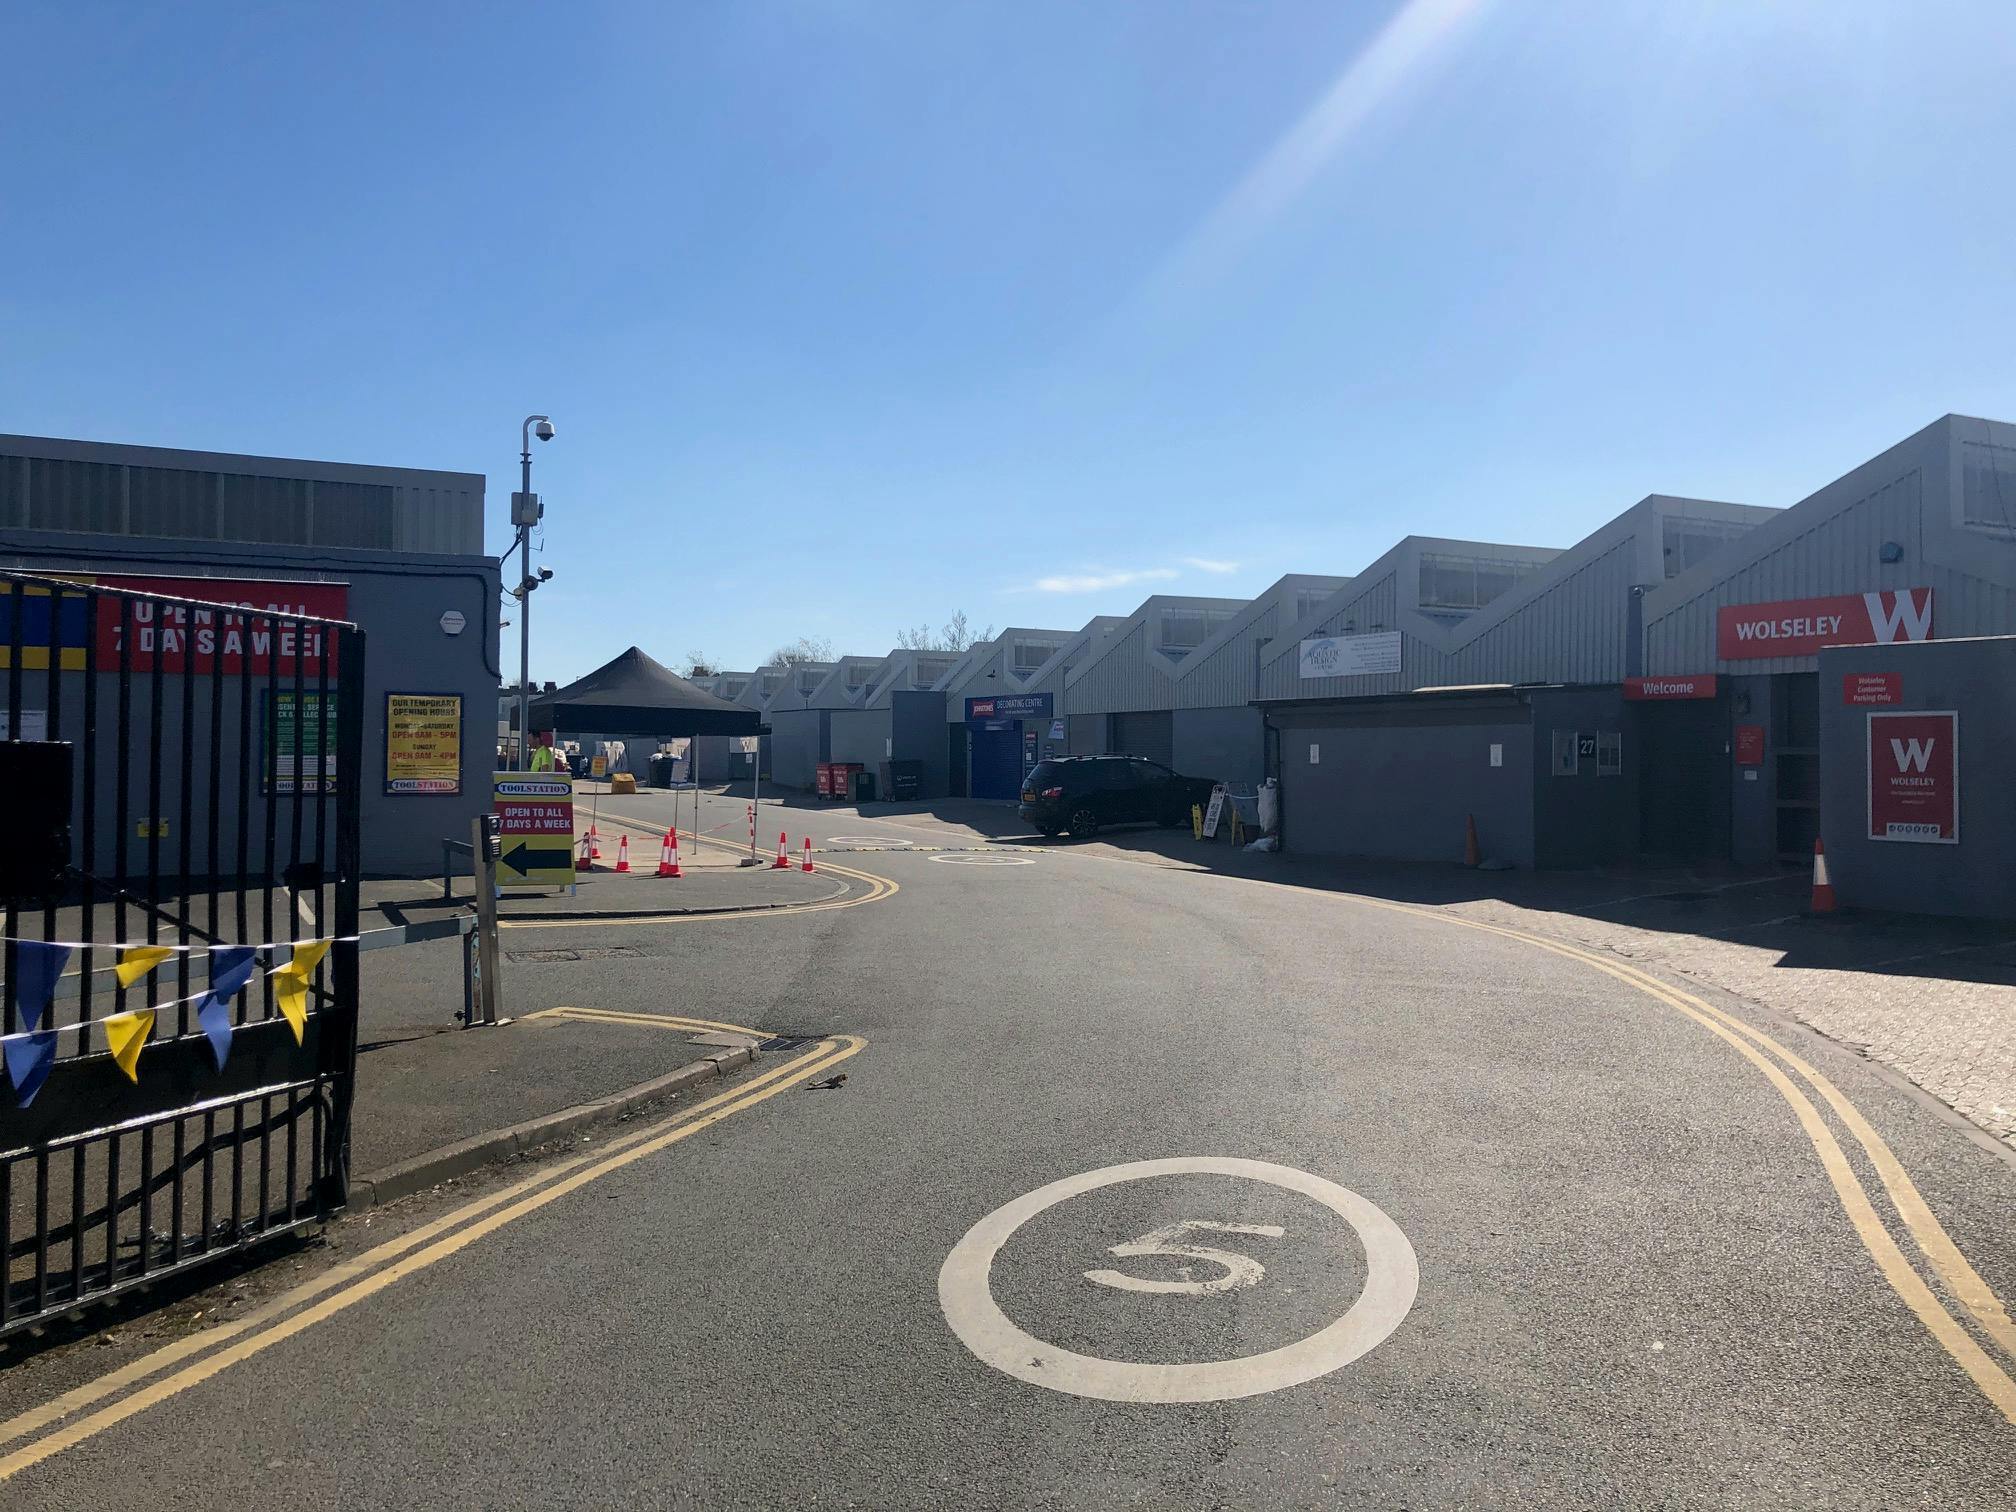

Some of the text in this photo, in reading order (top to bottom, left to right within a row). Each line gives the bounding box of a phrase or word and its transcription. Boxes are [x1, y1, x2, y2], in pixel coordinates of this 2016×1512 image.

[1736, 615, 1842, 641] WOLSELEY
[224, 630, 243, 655] A
[1643, 681, 1694, 695] Welcome
[1854, 694, 1892, 702] Parking Only
[394, 708, 428, 716] OPENING
[1581, 740, 1594, 754] 27
[1890, 738, 1935, 773] W
[394, 781, 454, 789] TOOLSTATION
[1890, 778, 1935, 786] WOLSELEY
[500, 784, 568, 793] TOOLSTATION
[505, 808, 564, 817] OPEN TO ALL
[506, 819, 531, 828] DAYS
[534, 819, 542, 828] A
[544, 819, 570, 828] WEEK
[1082, 1220, 1285, 1297] 5
